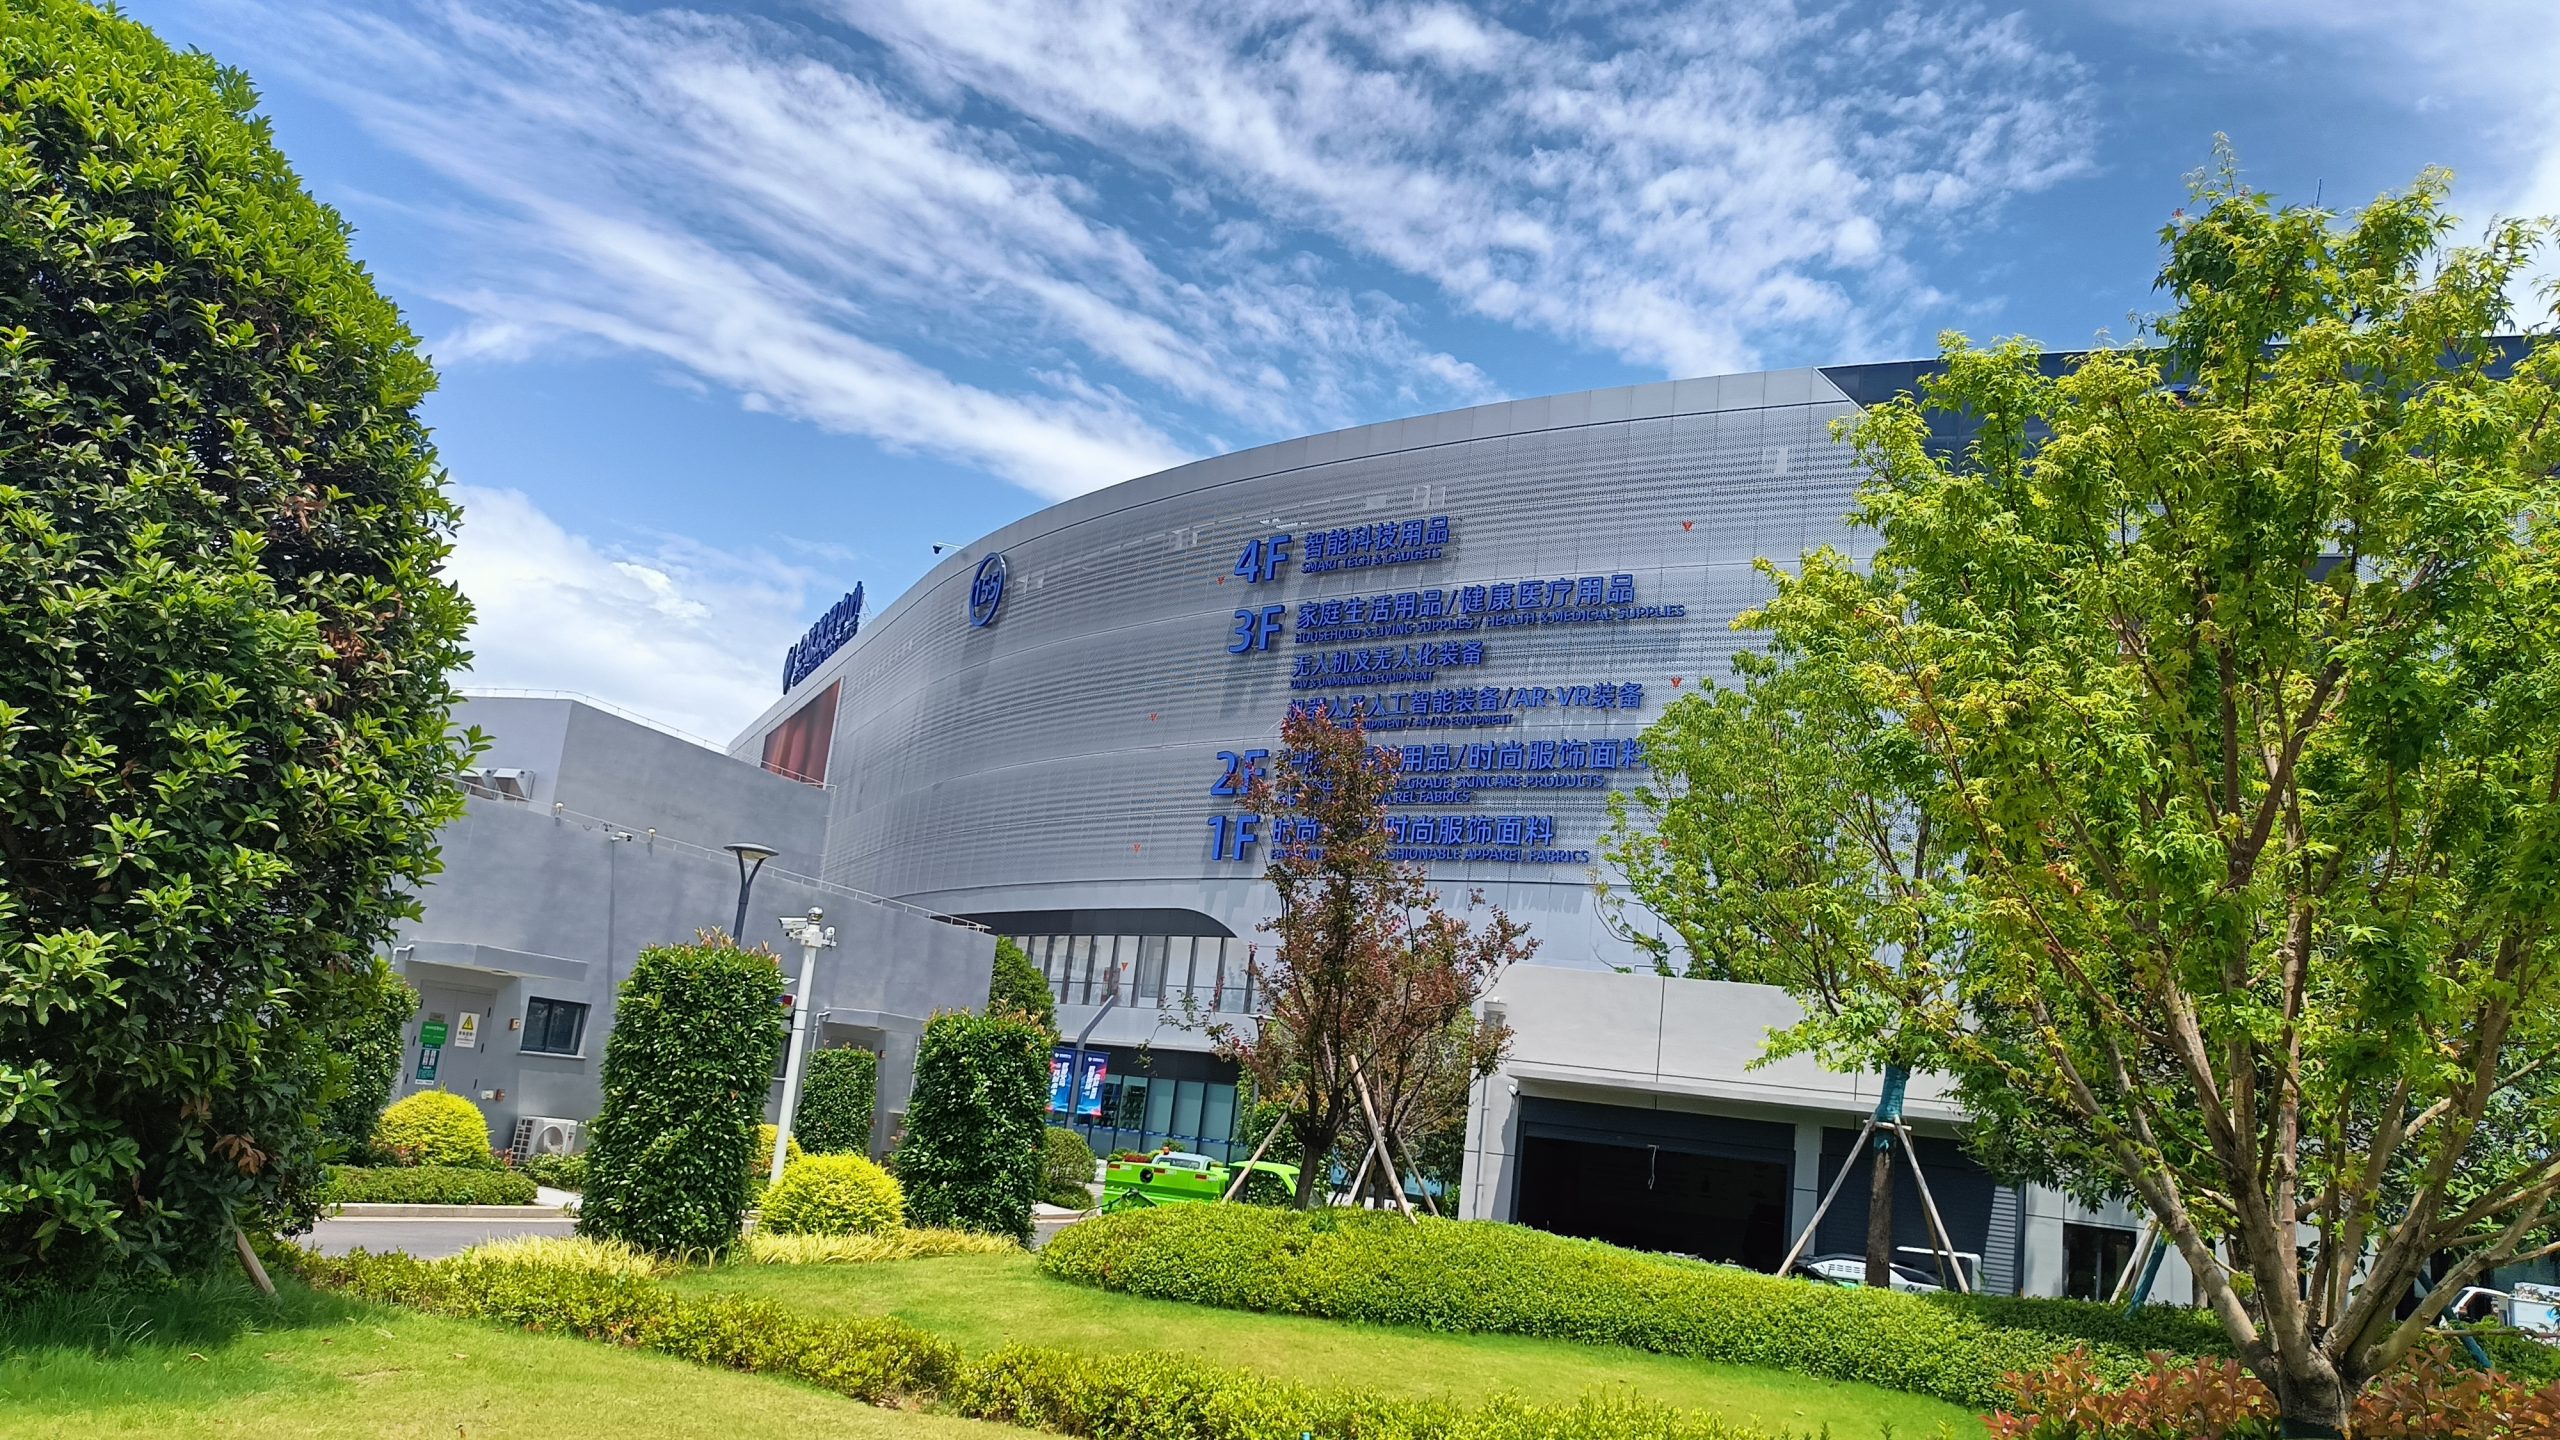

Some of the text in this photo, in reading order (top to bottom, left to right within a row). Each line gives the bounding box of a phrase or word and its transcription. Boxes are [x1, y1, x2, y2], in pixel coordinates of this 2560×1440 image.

[1303, 515, 1450, 561] 智能科技用品
[1234, 535, 1292, 583] 4F
[1301, 548, 1442, 574] SMART TECH & GADGETS
[1296, 574, 1635, 629] 家庭生活用品/健康医疗用品
[1229, 604, 1285, 654] 3F
[1295, 627, 1360, 644] HOUSEHOLD
[1364, 626, 1374, 638] &
[1375, 621, 1414, 638] LIVING
[1417, 616, 1474, 634] SUPPLIES
[1487, 612, 1536, 628] HEALTH
[1540, 611, 1550, 625] &
[1551, 607, 1613, 624] MEDICAL
[1617, 604, 1685, 620] SUPPLIES
[1292, 640, 1484, 678] 无人机及无人化装备
[1318, 673, 1374, 688] UNMANNED
[1375, 671, 1435, 684] EQUIPMENT
[1451, 714, 1513, 726] EQUIPMENT
[1209, 748, 1269, 796] 2F
[1456, 774, 1522, 789] SKINCARE
[1526, 774, 1605, 789] PRODUCTS
[1420, 789, 1471, 803] FABRICS
[1208, 814, 1260, 861] 1F
[1465, 849, 1523, 862] APPAREL
[1530, 850, 1590, 864] FABRICS
